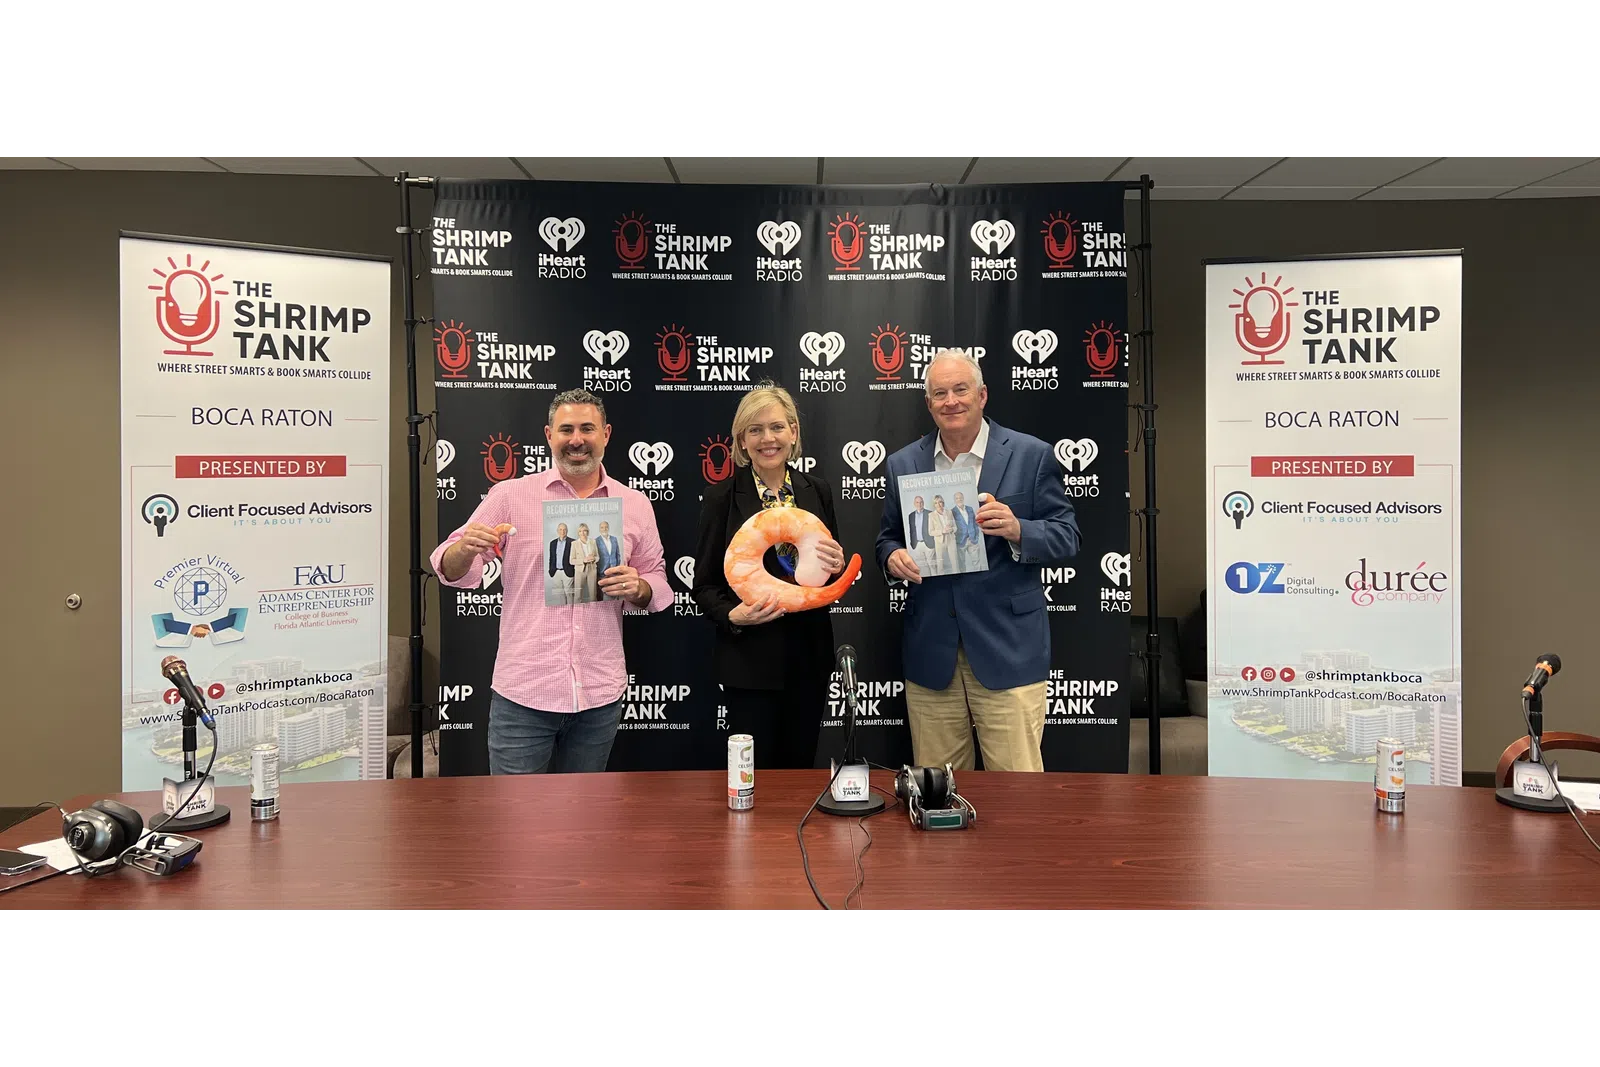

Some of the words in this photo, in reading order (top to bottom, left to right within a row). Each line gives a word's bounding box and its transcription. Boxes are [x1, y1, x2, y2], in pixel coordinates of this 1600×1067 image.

[433, 217, 456, 228] THE
[655, 224, 676, 234] THE
[869, 224, 890, 234] THE
[1082, 222, 1103, 232] THE
[433, 229, 512, 247] SHRIMP
[655, 235, 732, 252] SHRIMP
[870, 234, 945, 252] SHRIMP
[433, 248, 488, 266] TANK
[538, 254, 586, 266] iHeart
[655, 254, 708, 271] TANK
[756, 257, 802, 270] iHeart
[869, 252, 922, 270] TANK
[971, 256, 1016, 269] iHeart
[538, 267, 586, 278] RADIO
[756, 270, 802, 282] RADIO
[971, 270, 1017, 282] RADIO
[233, 280, 272, 298] THE
[1302, 290, 1340, 306] THE
[234, 300, 371, 334] SHRIMP
[1302, 306, 1440, 335] SHRIMP
[476, 332, 498, 342] THE
[696, 336, 718, 346] THE
[910, 334, 931, 344] THE
[233, 332, 331, 362] TANK
[476, 344, 556, 362] SHRIMP
[1302, 336, 1398, 364] TANK
[696, 347, 774, 364] SHRIMP
[158, 363, 192, 373] WHERE
[195, 364, 227, 374] STREET
[230, 365, 266, 376] SMARTS
[268, 367, 274, 376] &
[276, 368, 300, 377] BOOK
[302, 368, 336, 378] SMARTS
[338, 370, 371, 380] COLLIDE
[476, 362, 532, 380] TANK
[584, 366, 630, 380] iHeart
[696, 365, 750, 382] TANK
[800, 368, 846, 380] iHeart
[1012, 366, 1058, 378] iHeart
[1236, 372, 1266, 381] WHERE
[1268, 371, 1297, 380] STREET
[1299, 370, 1332, 380] SMARTS
[1334, 371, 1341, 380] &
[1344, 370, 1367, 380] BOOK
[1369, 370, 1404, 379] SMARTS
[1406, 368, 1440, 378] COLLIDE
[584, 380, 632, 392] RADIO
[800, 381, 846, 392] RADIO
[1012, 379, 1058, 390] RADIO
[192, 408, 254, 426] BOCA
[262, 409, 332, 426] RATON
[1265, 411, 1322, 428] BOCA
[1329, 410, 1399, 428] RATON
[523, 446, 545, 455] THE
[200, 460, 300, 476] PRESENTED
[306, 460, 326, 474] BY
[1272, 460, 1366, 474] PRESENTED
[1372, 460, 1392, 474] BY
[628, 476, 674, 489] iHeart
[842, 476, 886, 488] iHeart
[902, 476, 932, 488] RECOVERY
[934, 472, 971, 484] REVOLUTION
[187, 504, 234, 518] Client
[238, 502, 304, 516] Focused
[309, 502, 372, 514] Advisors
[546, 504, 578, 514] RECOVERY
[1261, 501, 1303, 514] Client
[1307, 501, 1372, 514] Focused
[1375, 501, 1442, 514] Advisors
[154, 558, 202, 589] Premier
[207, 554, 245, 584] Virtual
[294, 564, 346, 586] FAU
[1345, 558, 1448, 592] durée
[1287, 578, 1314, 587] Digital
[258, 592, 303, 603] ADAMS
[306, 589, 350, 600] CENTER
[354, 587, 374, 596] FOR
[456, 592, 502, 604] iHeart
[1351, 580, 1374, 606] &
[1377, 592, 1442, 604] company
[258, 598, 374, 614] ENTREPRENEURSHIP
[285, 612, 310, 620] College
[274, 622, 298, 630] Florida
[299, 620, 324, 628] Atlantic
[326, 618, 358, 626] University
[236, 672, 352, 694] @shrimptankboca
[1305, 670, 1422, 684] @shrimptankboca
[1222, 687, 1446, 702] www.ShrimpTankPodcast.com/BocaRaton
[187, 804, 206, 812] TANK
